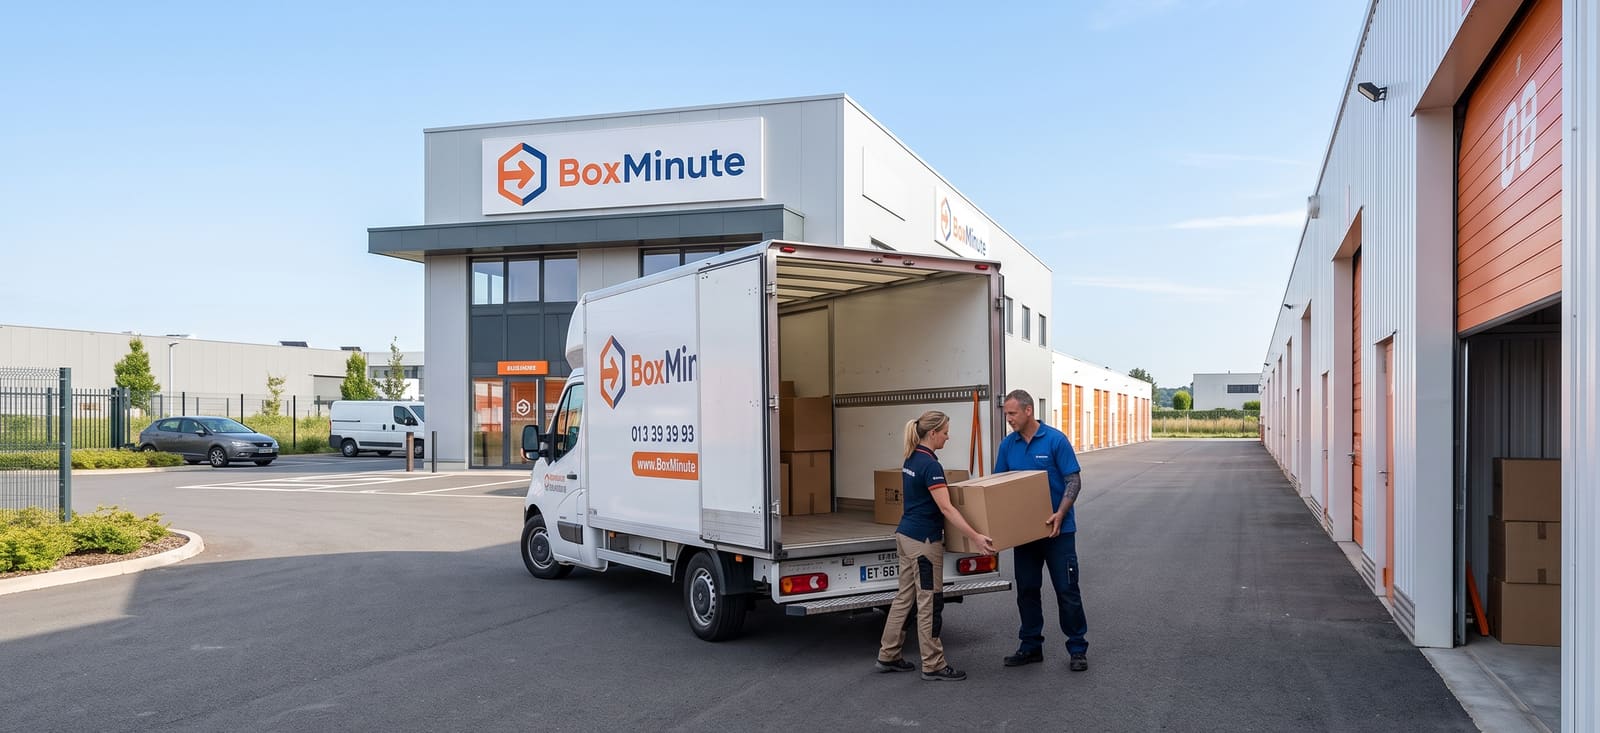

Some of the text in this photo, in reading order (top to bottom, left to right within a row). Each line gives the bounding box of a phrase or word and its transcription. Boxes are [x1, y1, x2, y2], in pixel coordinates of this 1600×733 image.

[1501, 79, 1538, 189] 08
[559, 149, 746, 187] BoxMinute
[953, 215, 987, 257] BoxMinute
[631, 424, 695, 443] 013 39 39 93
[637, 457, 696, 473] www.BoxMinute
